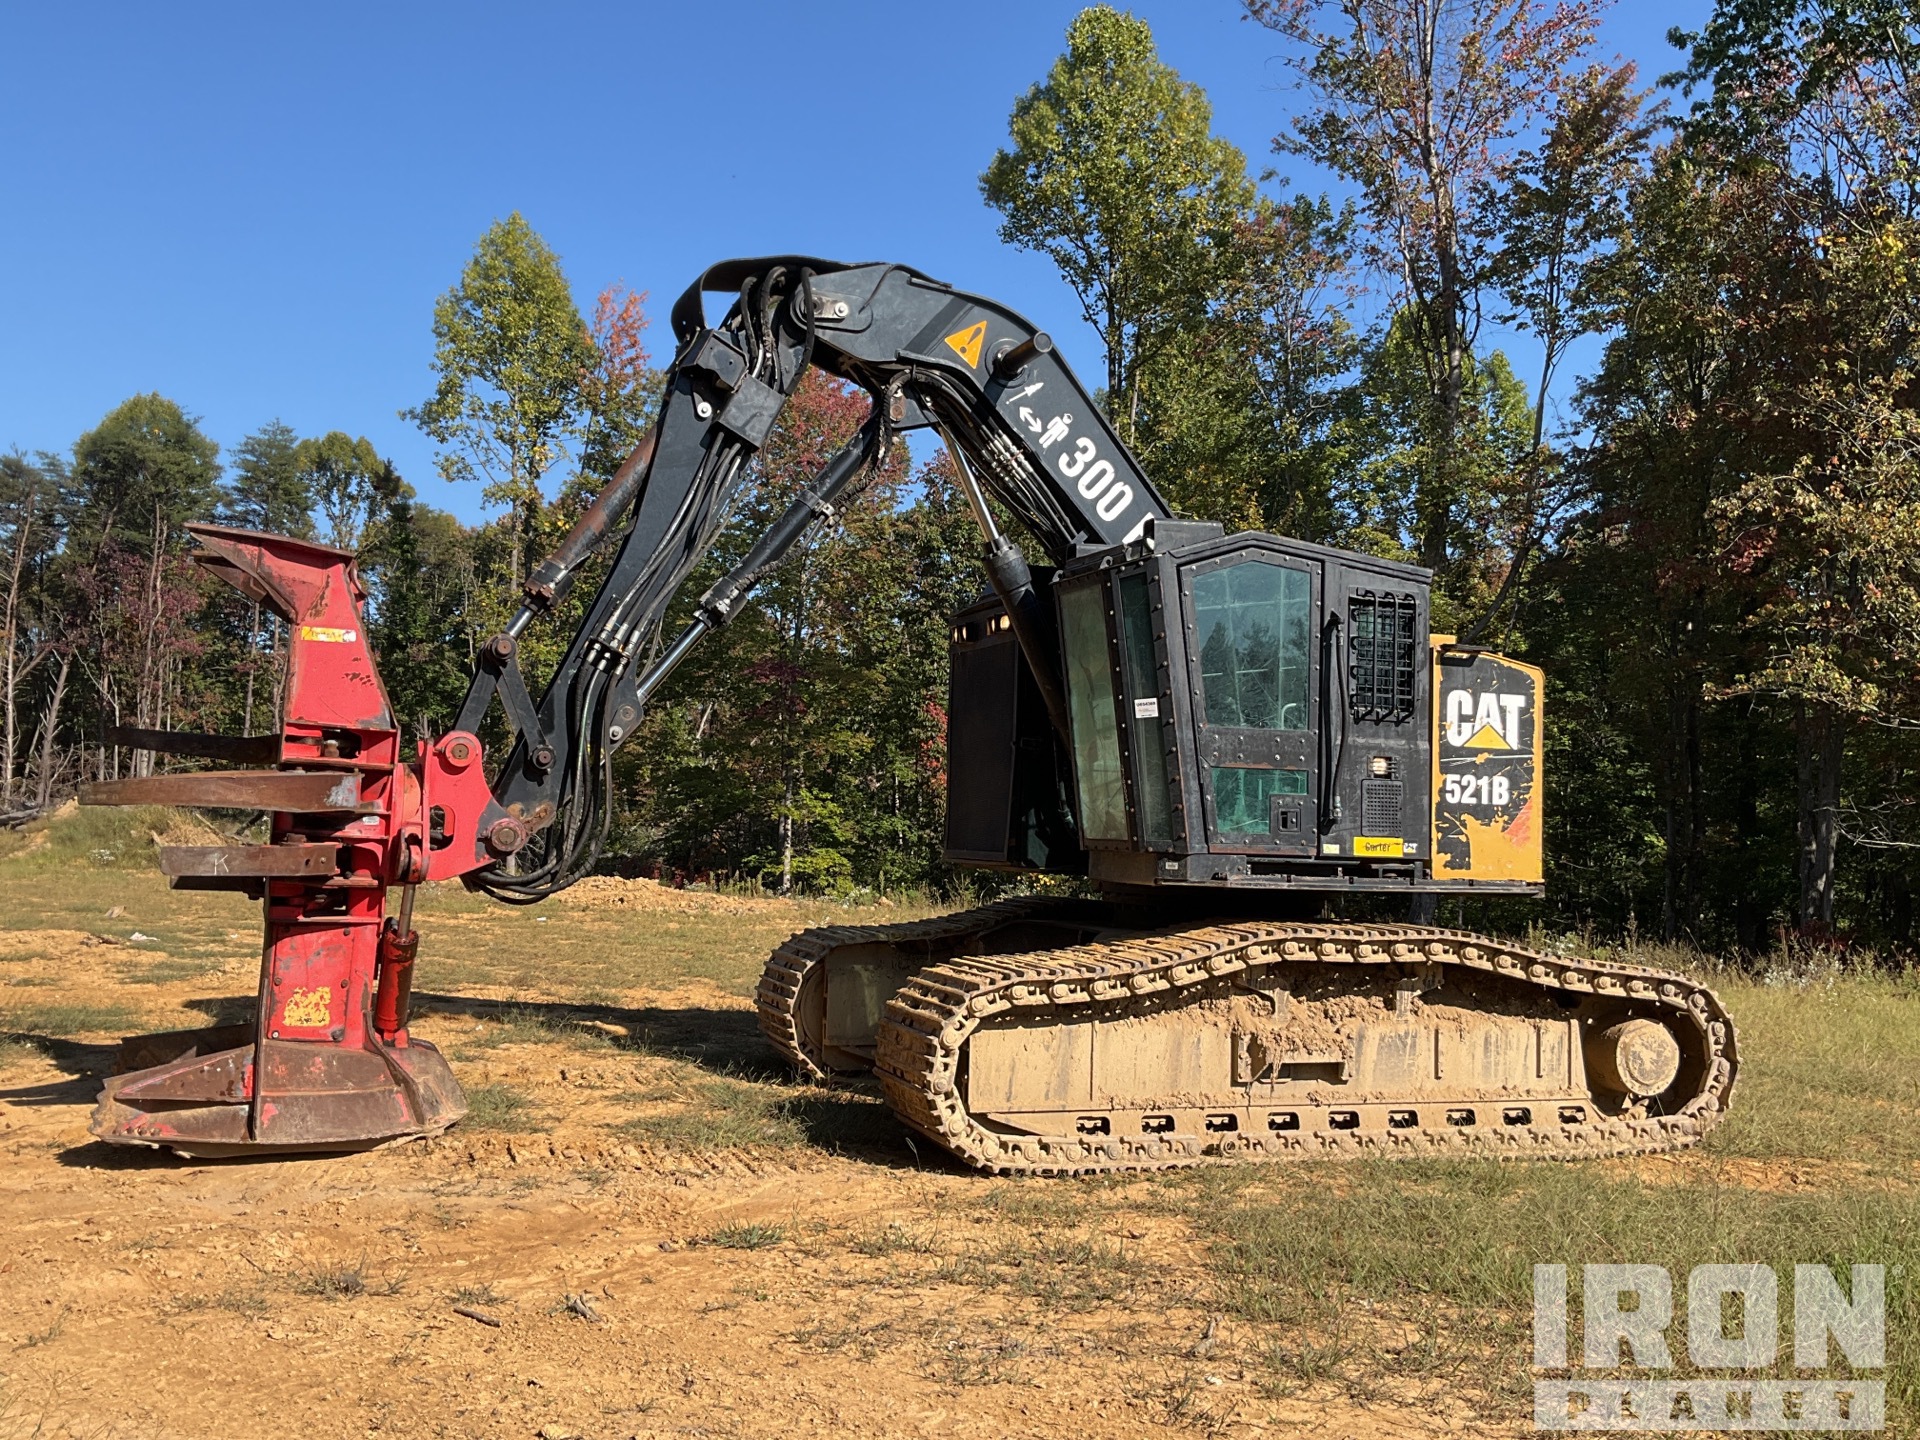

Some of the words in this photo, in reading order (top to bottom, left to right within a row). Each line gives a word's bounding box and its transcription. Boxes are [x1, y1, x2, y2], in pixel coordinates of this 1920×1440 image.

[1058, 437, 1134, 522] 300
[1446, 689, 1526, 750] CAT
[1445, 774, 1510, 805] 521B
